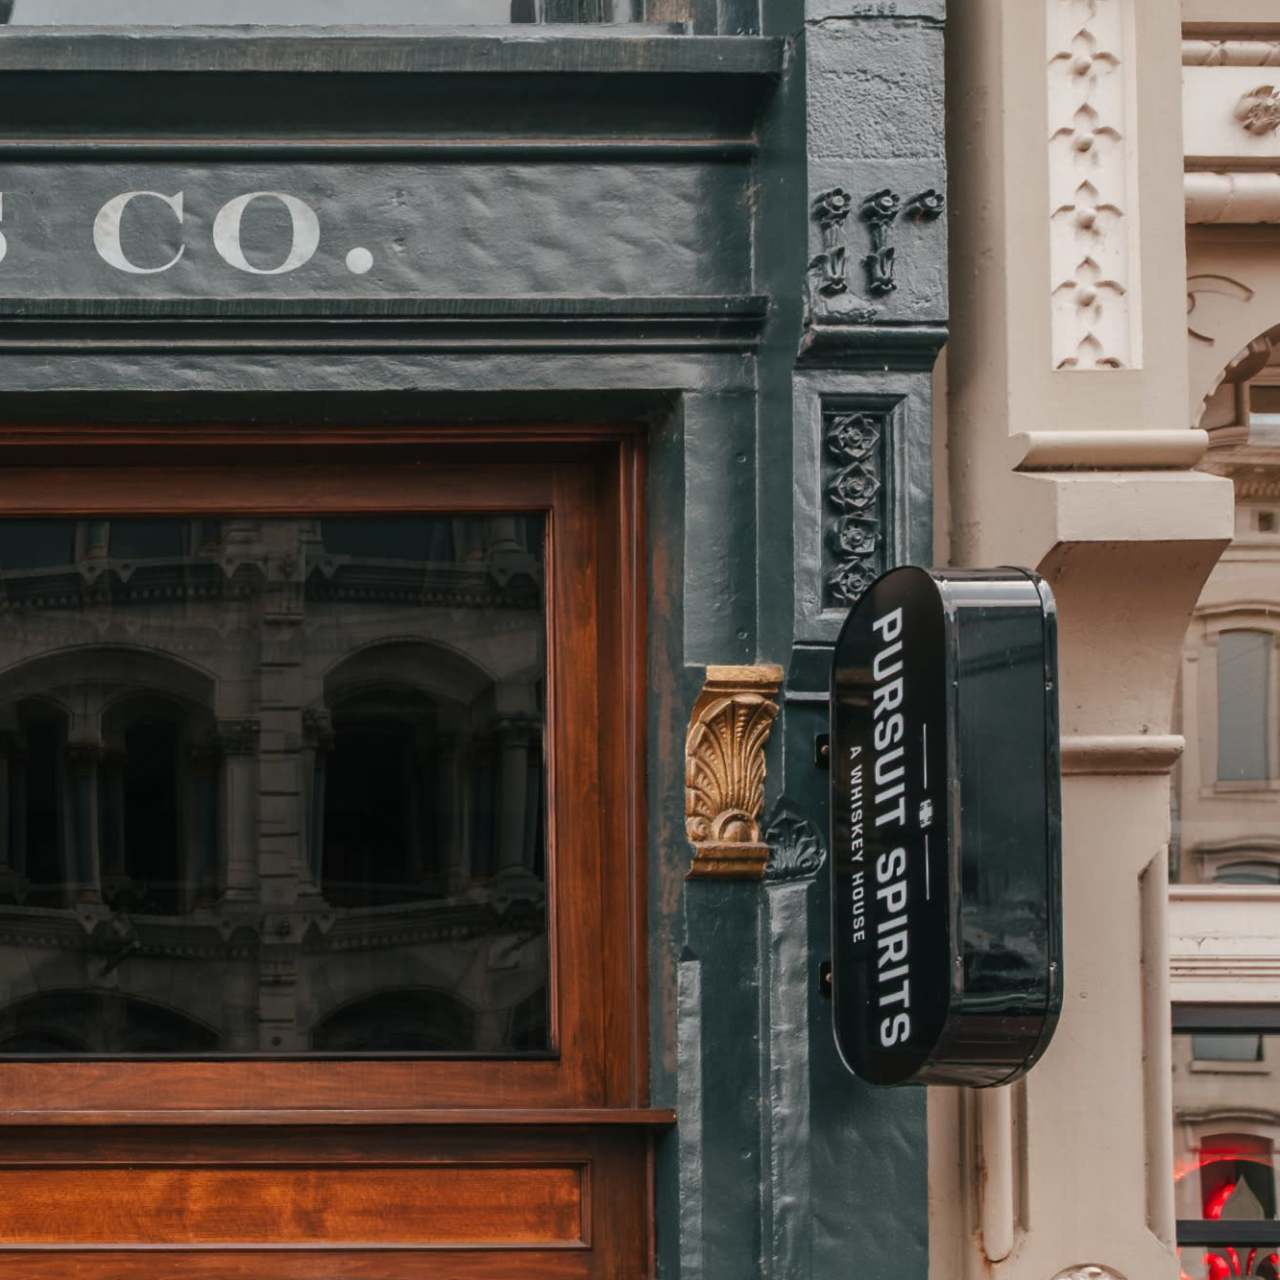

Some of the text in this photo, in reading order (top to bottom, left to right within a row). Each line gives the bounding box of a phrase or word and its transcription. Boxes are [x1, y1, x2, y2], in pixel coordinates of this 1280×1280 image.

[92, 189, 376, 275] CO.
[850, 745, 865, 943] A WHISKEY HOUSE
[872, 606, 911, 1048] PURSUIT SPIRITS
